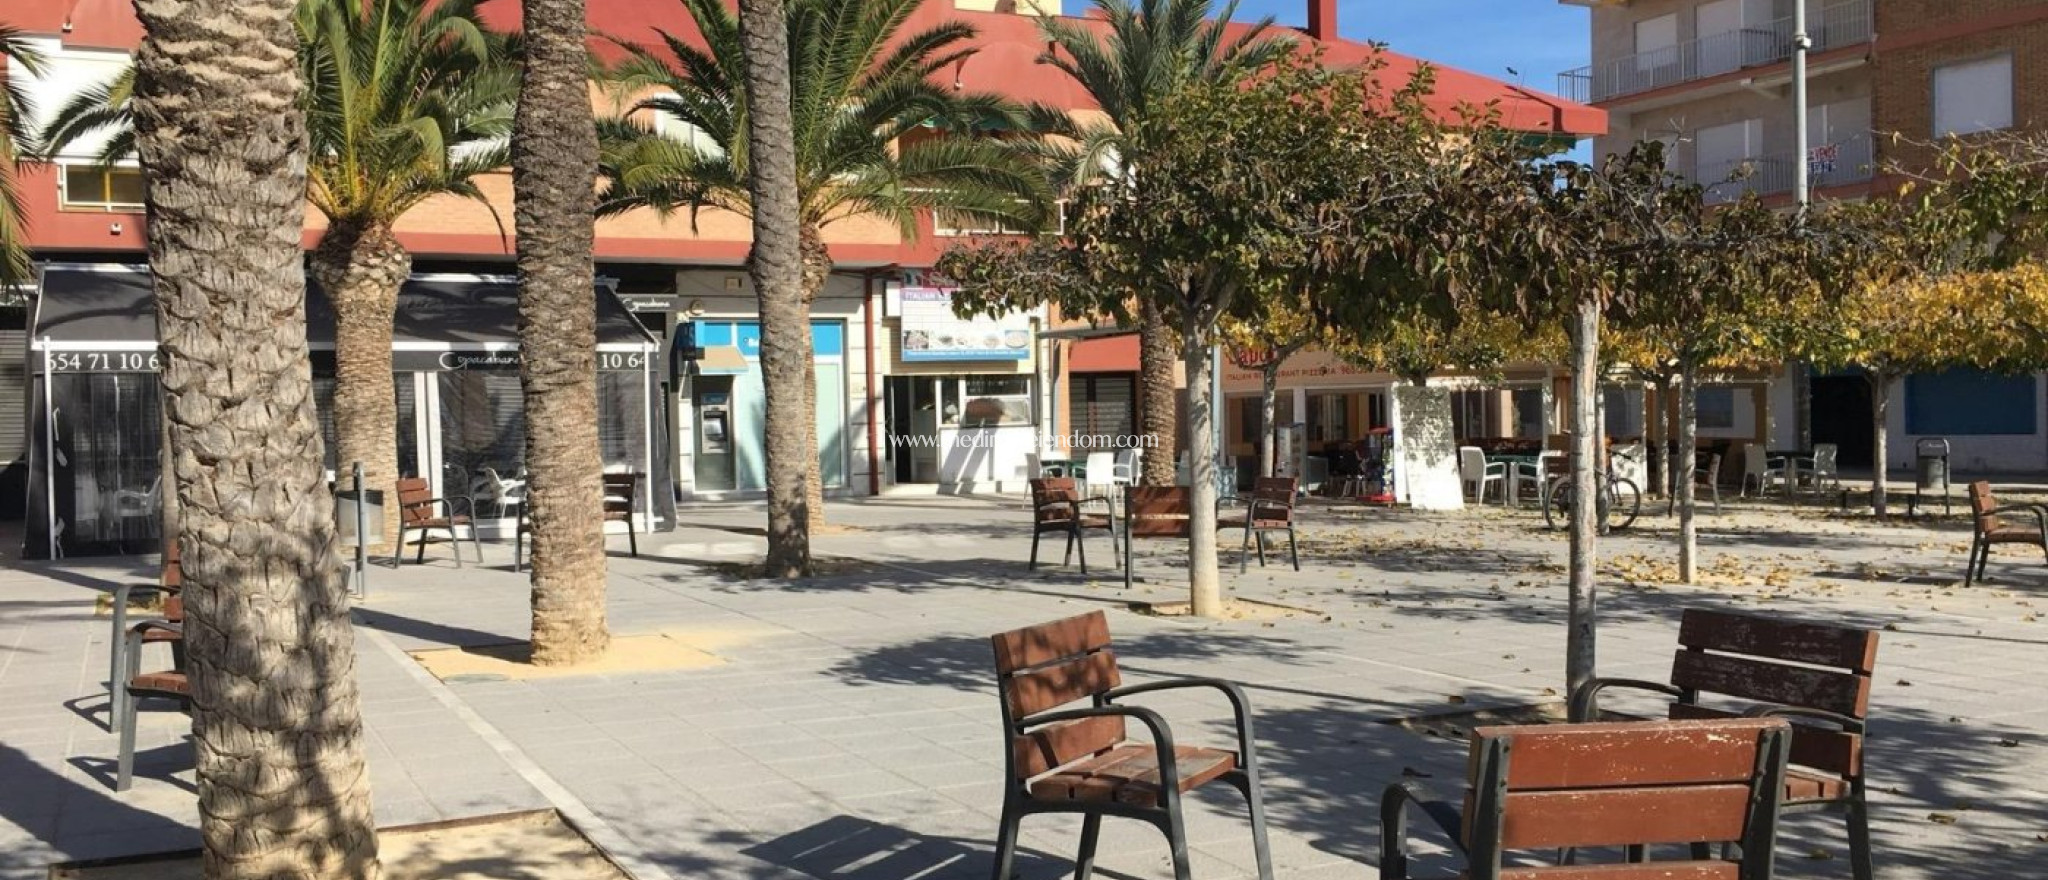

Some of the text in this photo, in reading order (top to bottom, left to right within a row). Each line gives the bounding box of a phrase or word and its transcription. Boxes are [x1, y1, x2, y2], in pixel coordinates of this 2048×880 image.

[87, 353, 110, 369] 71
[120, 353, 142, 369] 10
[148, 353, 159, 370] 6
[601, 353, 622, 368] 10
